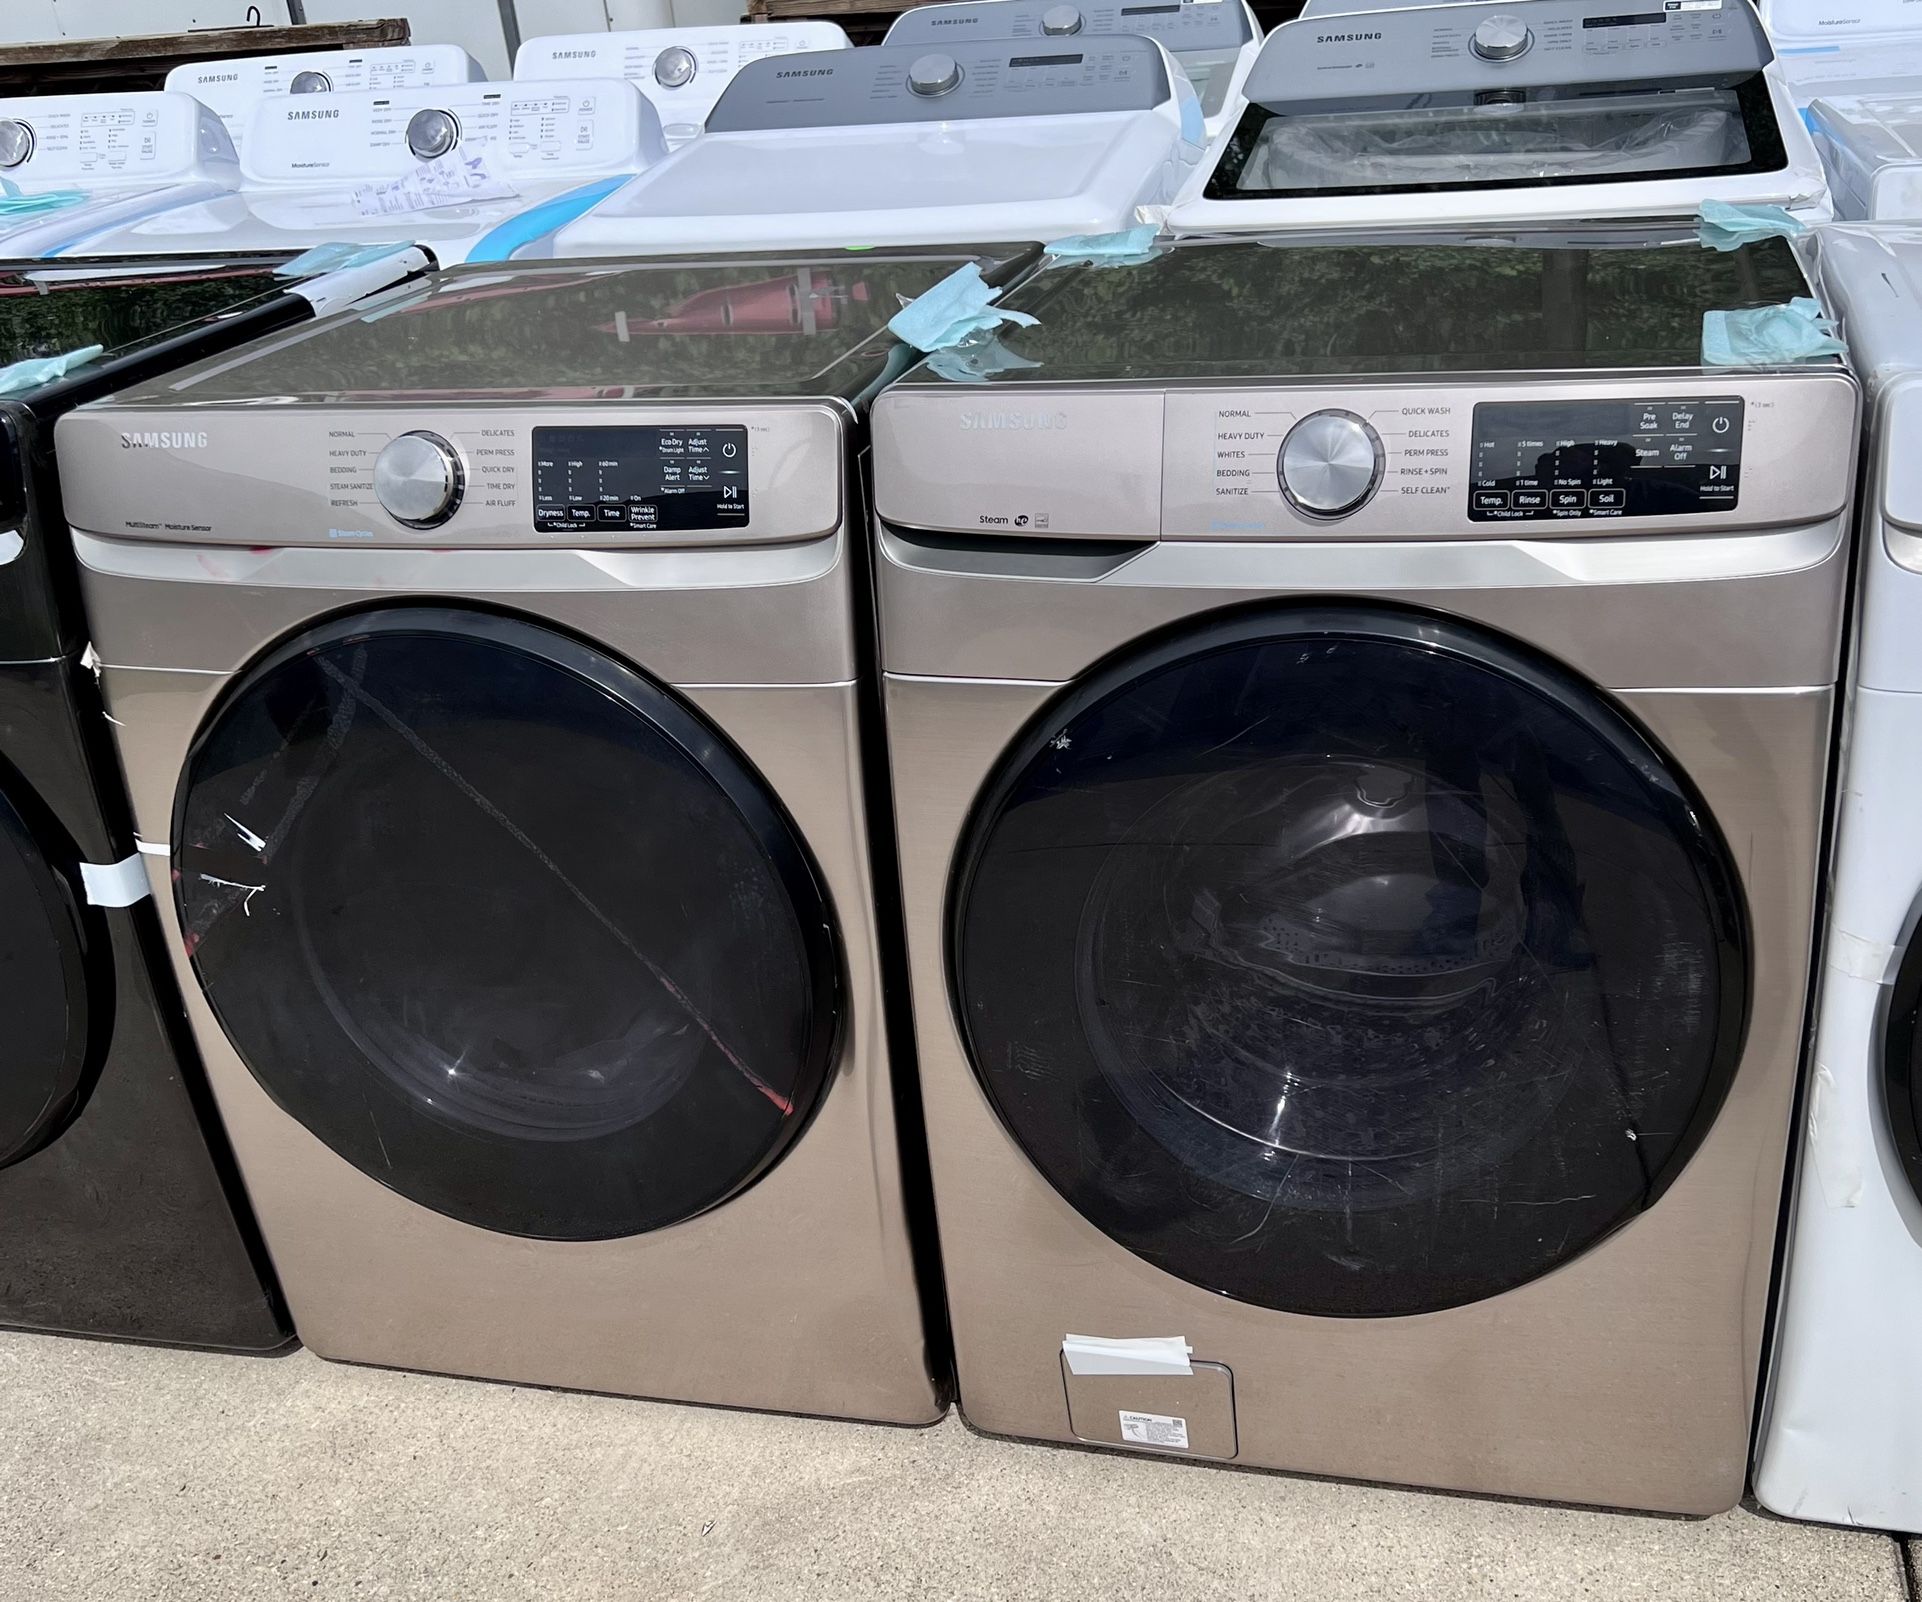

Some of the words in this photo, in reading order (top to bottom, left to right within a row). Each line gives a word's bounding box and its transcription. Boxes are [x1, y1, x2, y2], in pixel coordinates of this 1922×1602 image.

[1316, 32, 1382, 44] SAMSUNG
[552, 50, 596, 60] SAMSUNG
[776, 68, 834, 79] SAMSUNG
[198, 74, 238, 84] SAMSUNG
[288, 109, 339, 120] SAMSUNG
[1402, 408, 1426, 416] QUICK
[959, 410, 1068, 430] SAMSUNG
[1672, 412, 1694, 422] Delay
[121, 432, 208, 448] SAMSUNG
[688, 439, 707, 447] Adjust
[1635, 448, 1660, 457] Steam
[1670, 444, 1693, 452] Alarm
[1674, 452, 1687, 460] Off
[689, 466, 707, 474] Adjust
[1480, 496, 1503, 505] Temp.
[1519, 496, 1541, 504] Rinse
[1559, 495, 1577, 504] Spin
[1599, 494, 1614, 503] Soil
[538, 509, 564, 518] Dryness
[979, 515, 1009, 524] Steam
